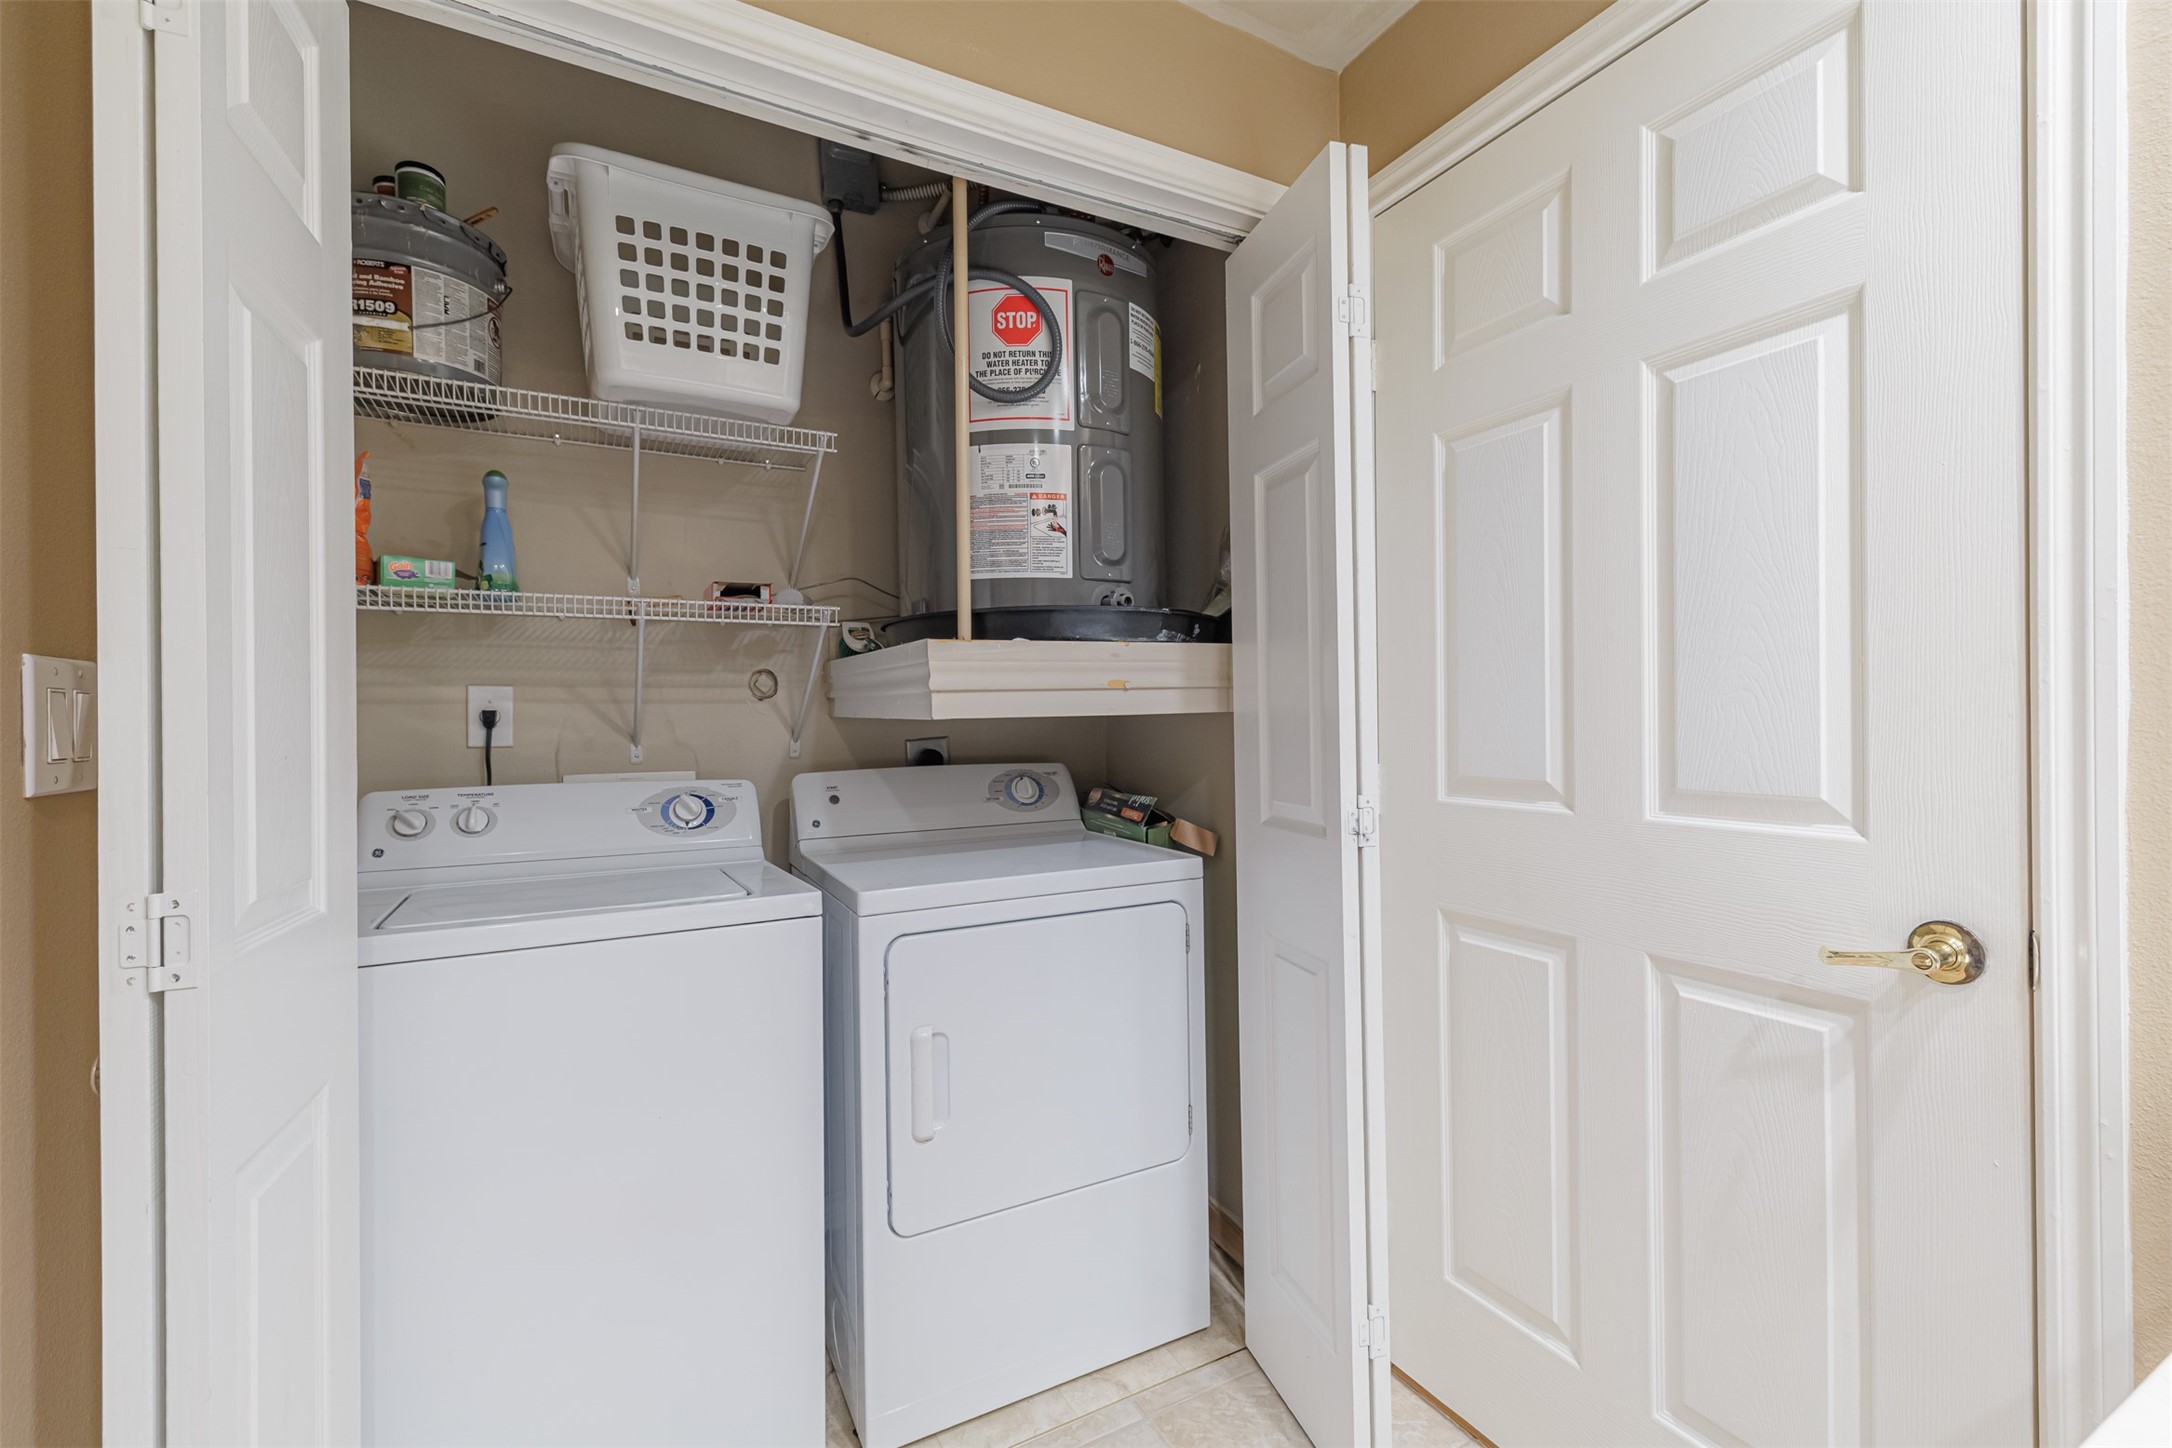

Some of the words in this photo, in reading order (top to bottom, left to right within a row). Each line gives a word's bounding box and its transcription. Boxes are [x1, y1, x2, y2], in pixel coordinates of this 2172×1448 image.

[1073, 238, 1130, 262] PERFORMANCE
[996, 311, 1037, 329] STOP
[981, 351, 991, 360] DO
[992, 350, 1006, 359] NOT
[1008, 350, 1036, 358] RETURN
[986, 360, 1010, 368] WATER
[1011, 359, 1039, 367] HEATER
[1040, 359, 1050, 367] TO
[975, 370, 988, 378] THE
[989, 368, 1011, 377] PLACE
[1013, 368, 1023, 376] OF
[388, 560, 414, 572] Gain
